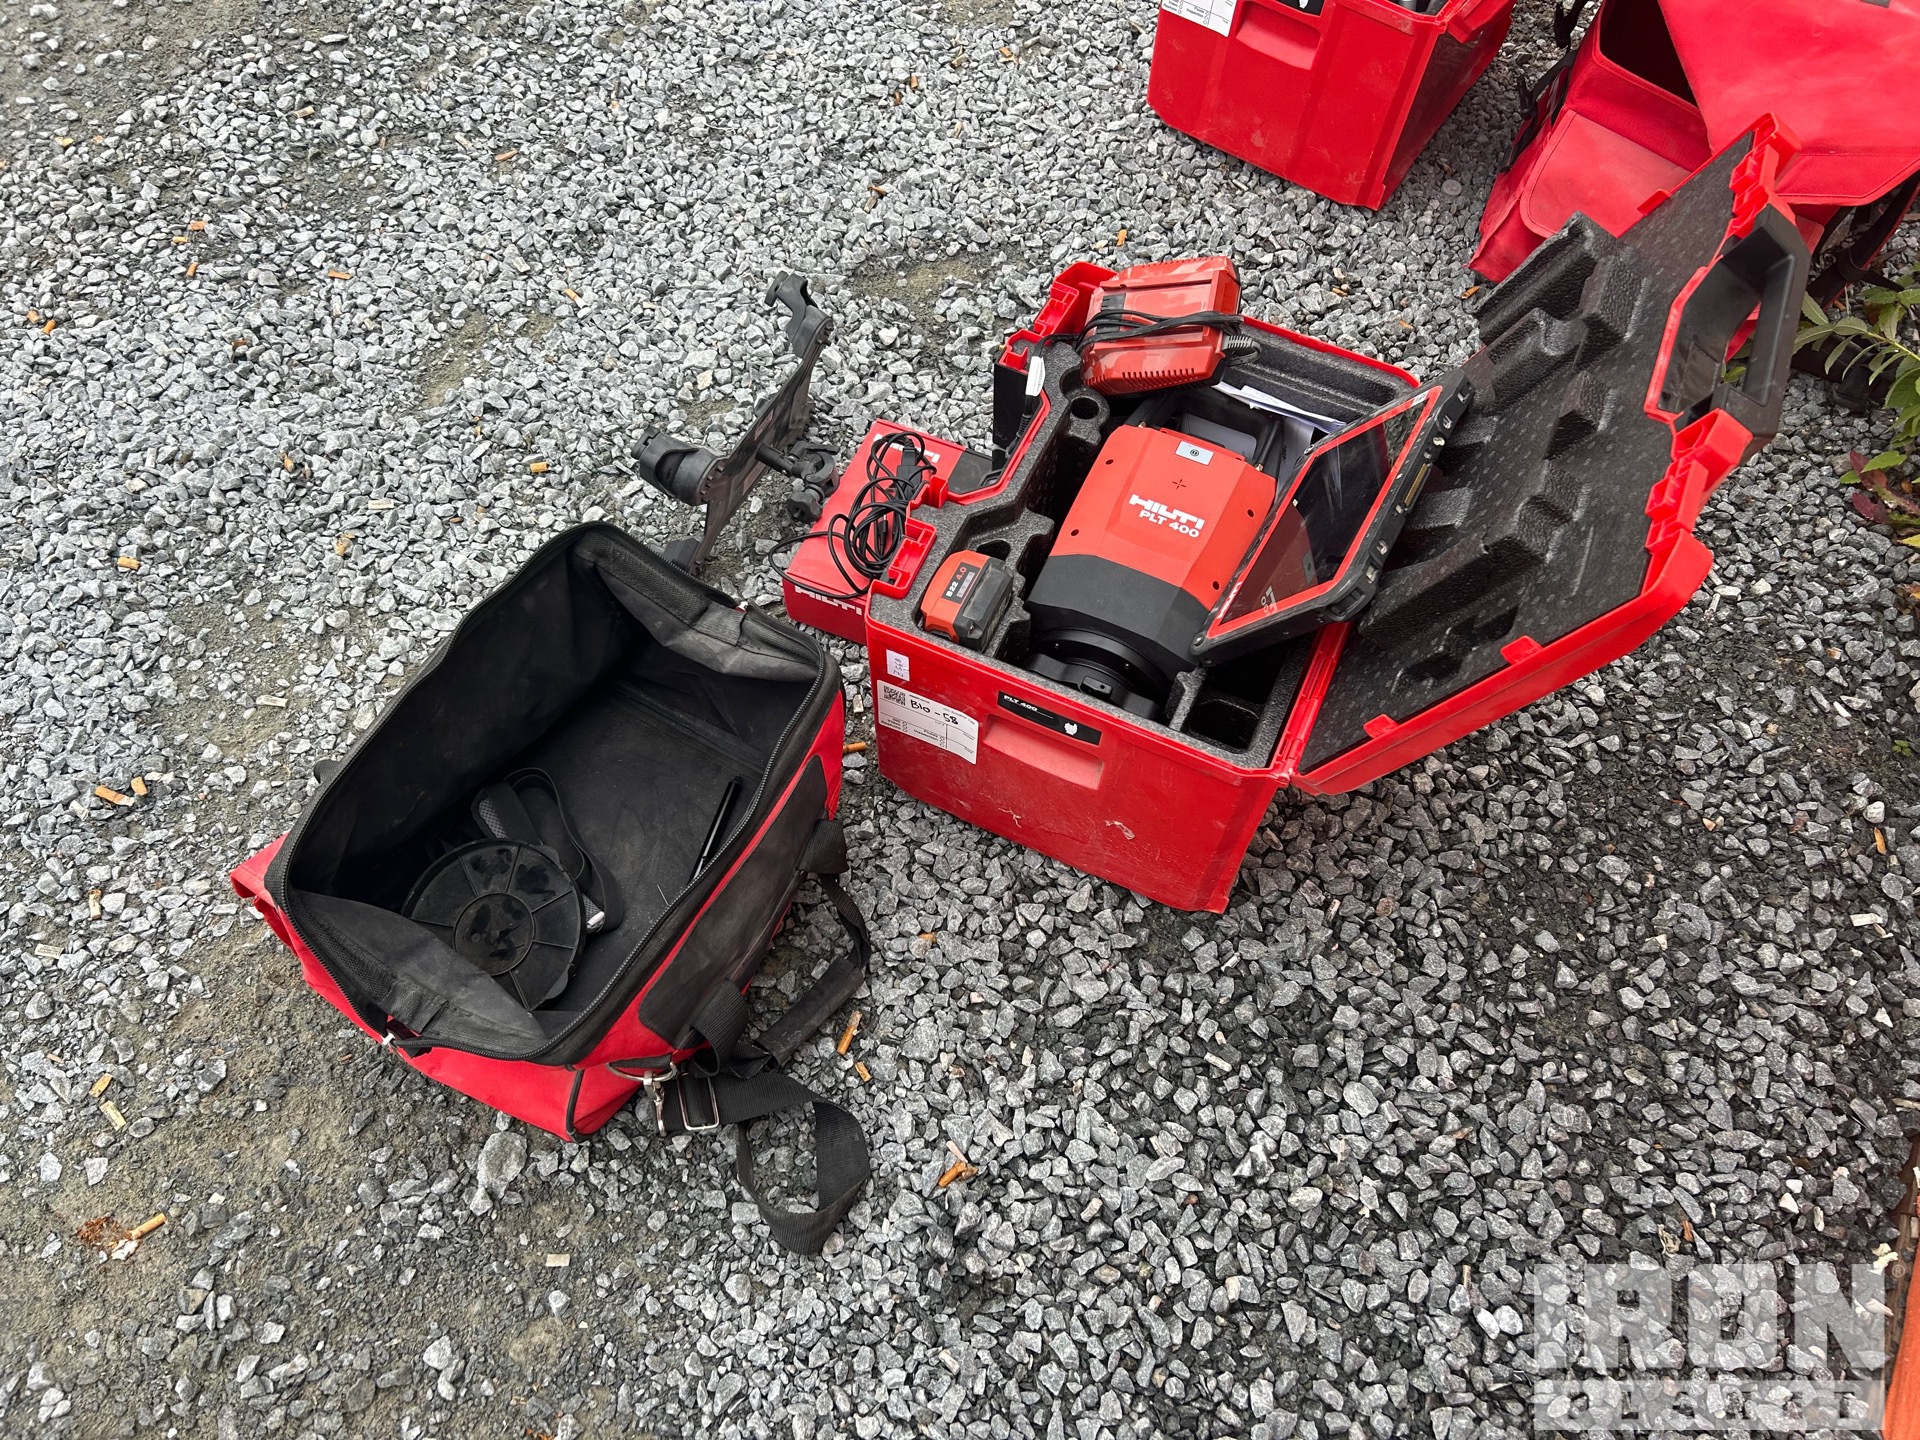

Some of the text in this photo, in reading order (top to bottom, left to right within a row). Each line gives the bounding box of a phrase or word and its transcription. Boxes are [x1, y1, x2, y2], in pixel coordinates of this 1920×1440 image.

[1129, 494, 1205, 530] HILTI
[1139, 509, 1200, 538] PLT 400
[945, 566, 967, 598] B22 4.0
[1003, 694, 1038, 712] PLT 400
